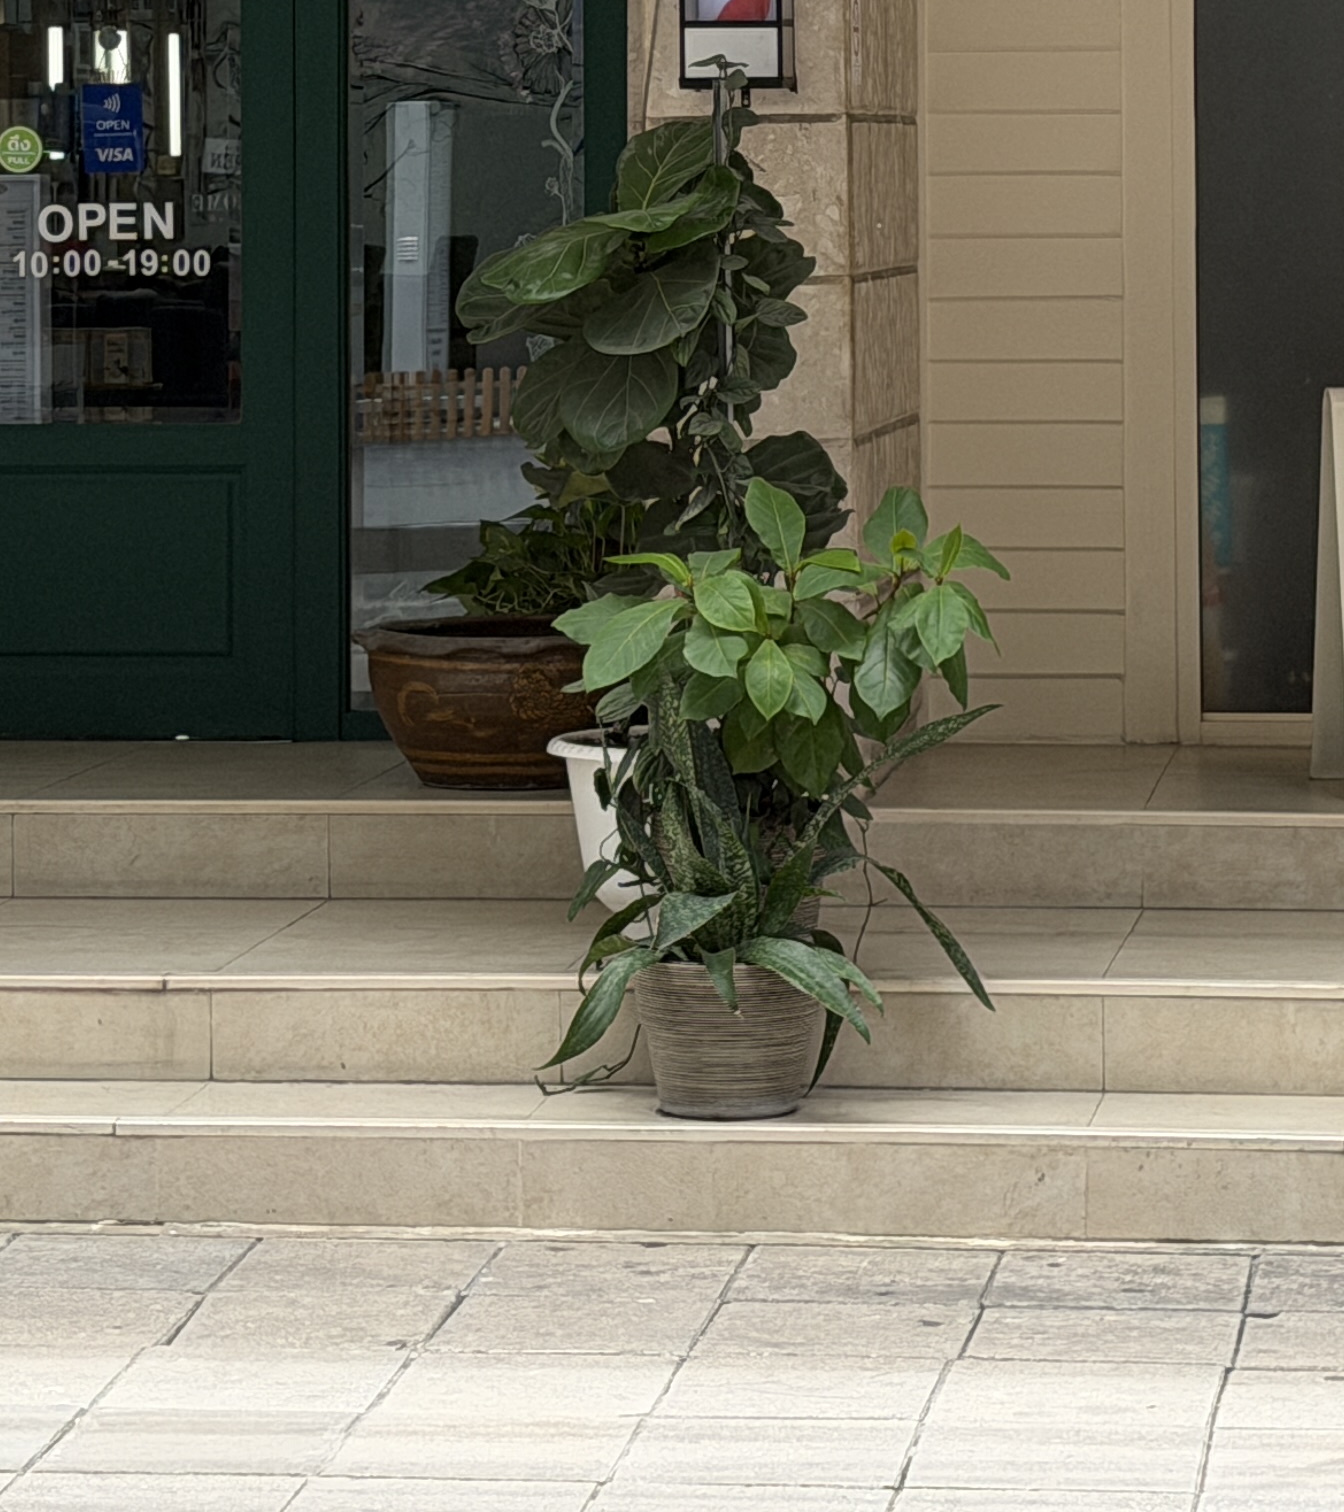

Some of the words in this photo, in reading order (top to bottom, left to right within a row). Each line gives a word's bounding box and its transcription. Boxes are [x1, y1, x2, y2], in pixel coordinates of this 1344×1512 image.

[96, 119, 131, 131] OPEN
[7, 156, 31, 165] PULL
[94, 147, 134, 163] VISA
[37, 201, 175, 243] OPEN
